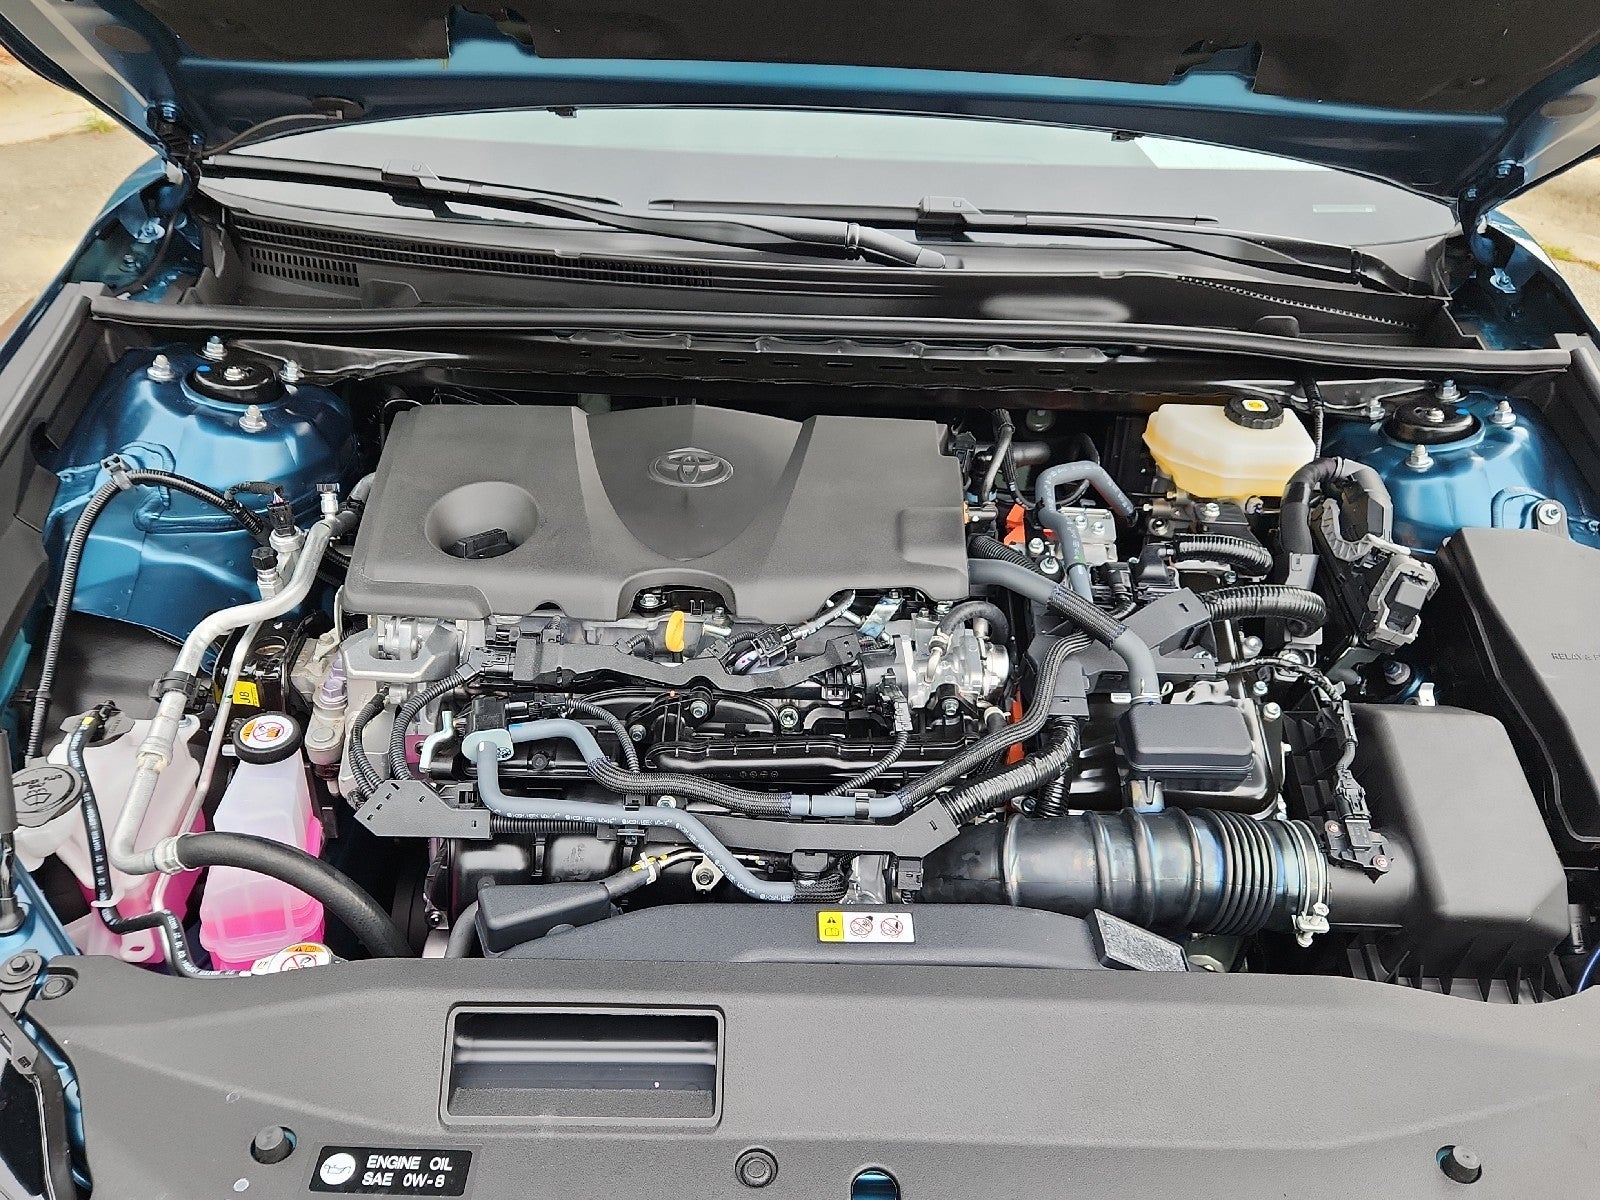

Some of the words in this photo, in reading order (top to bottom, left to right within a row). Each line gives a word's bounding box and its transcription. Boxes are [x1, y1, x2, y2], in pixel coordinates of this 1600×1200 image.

[1551, 652, 1582, 661] RELAY
[13, 778, 39, 788] ASHER
[366, 1154, 421, 1170] ENGINE
[429, 1156, 453, 1171] OIL
[362, 1171, 394, 1186] SAE
[402, 1173, 446, 1188] 0W-8
